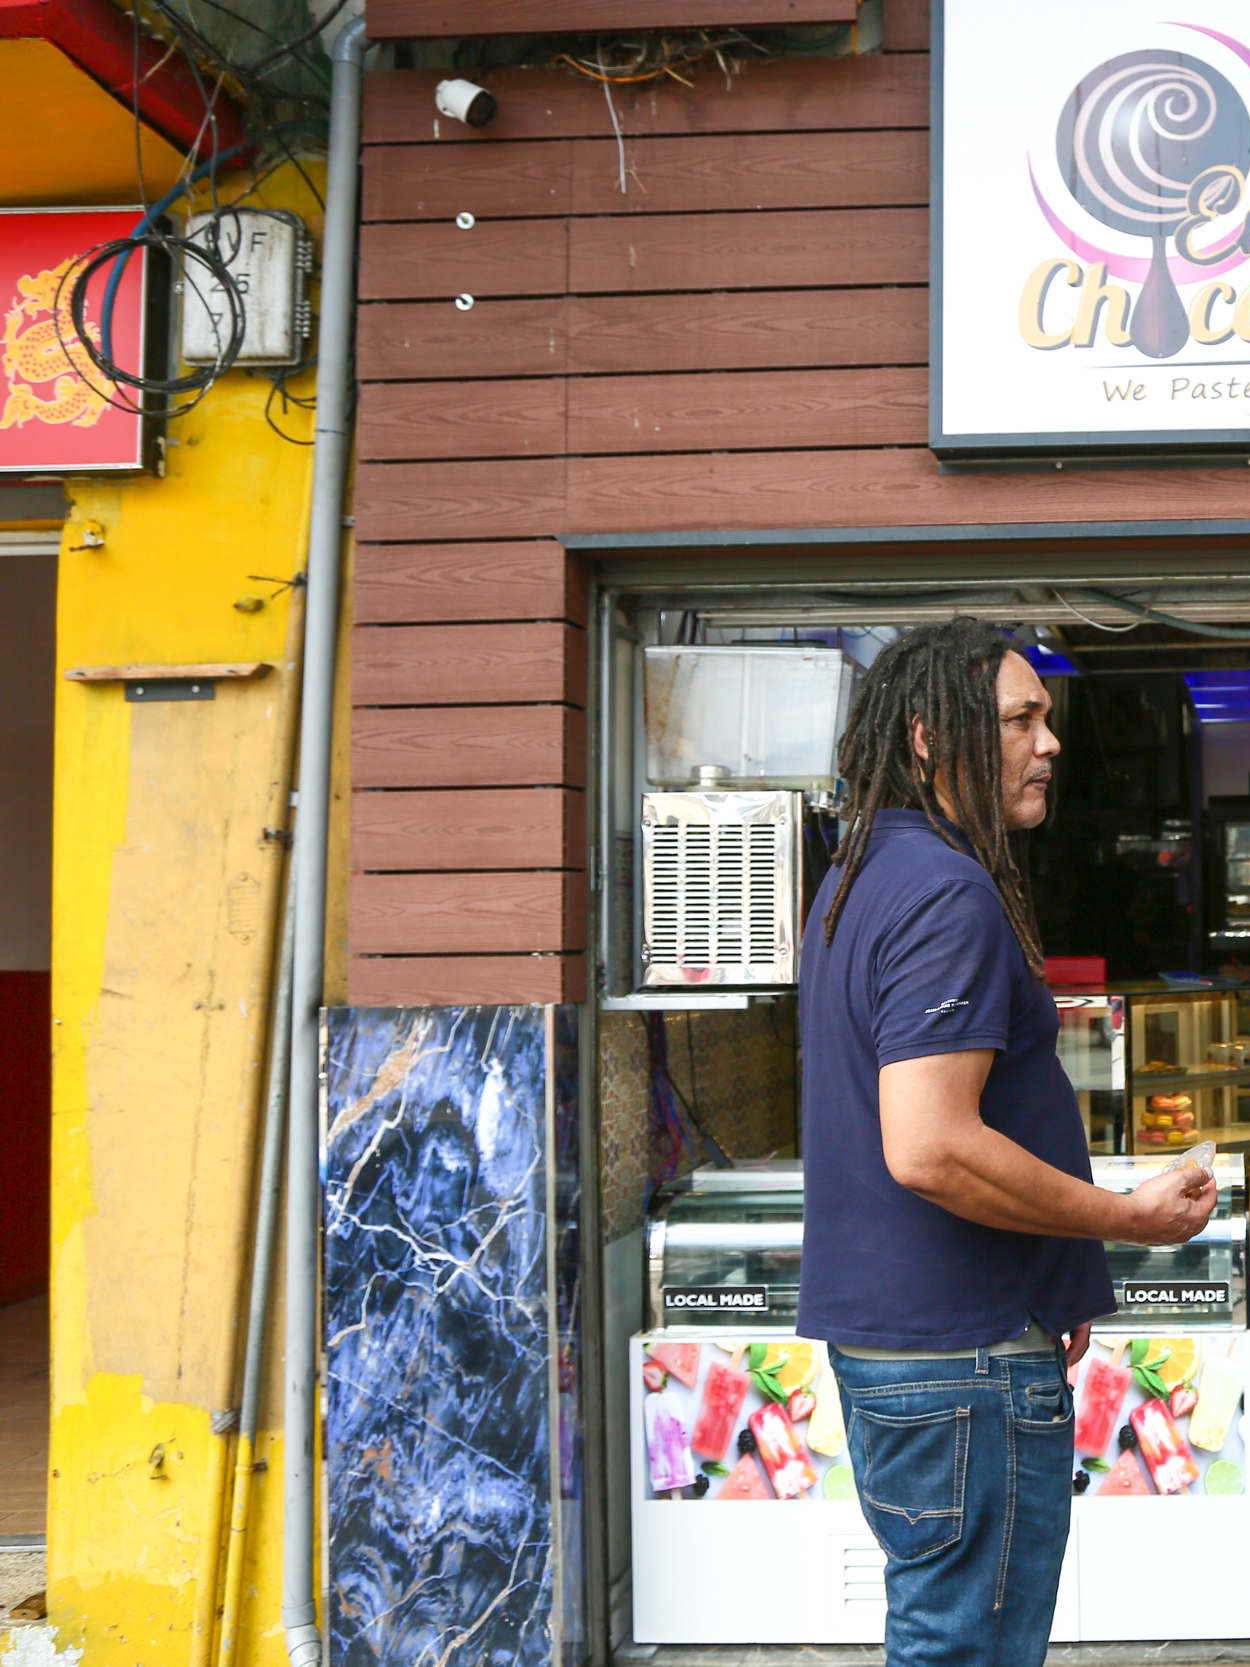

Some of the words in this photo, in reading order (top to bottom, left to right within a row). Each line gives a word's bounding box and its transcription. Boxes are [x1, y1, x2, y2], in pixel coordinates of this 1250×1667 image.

[1102, 378, 1147, 402] We
[665, 1294, 717, 1307] LOCAL
[720, 1293, 764, 1306] MADE
[1126, 1290, 1179, 1302] LOCAL
[1181, 1289, 1226, 1302] MADE
